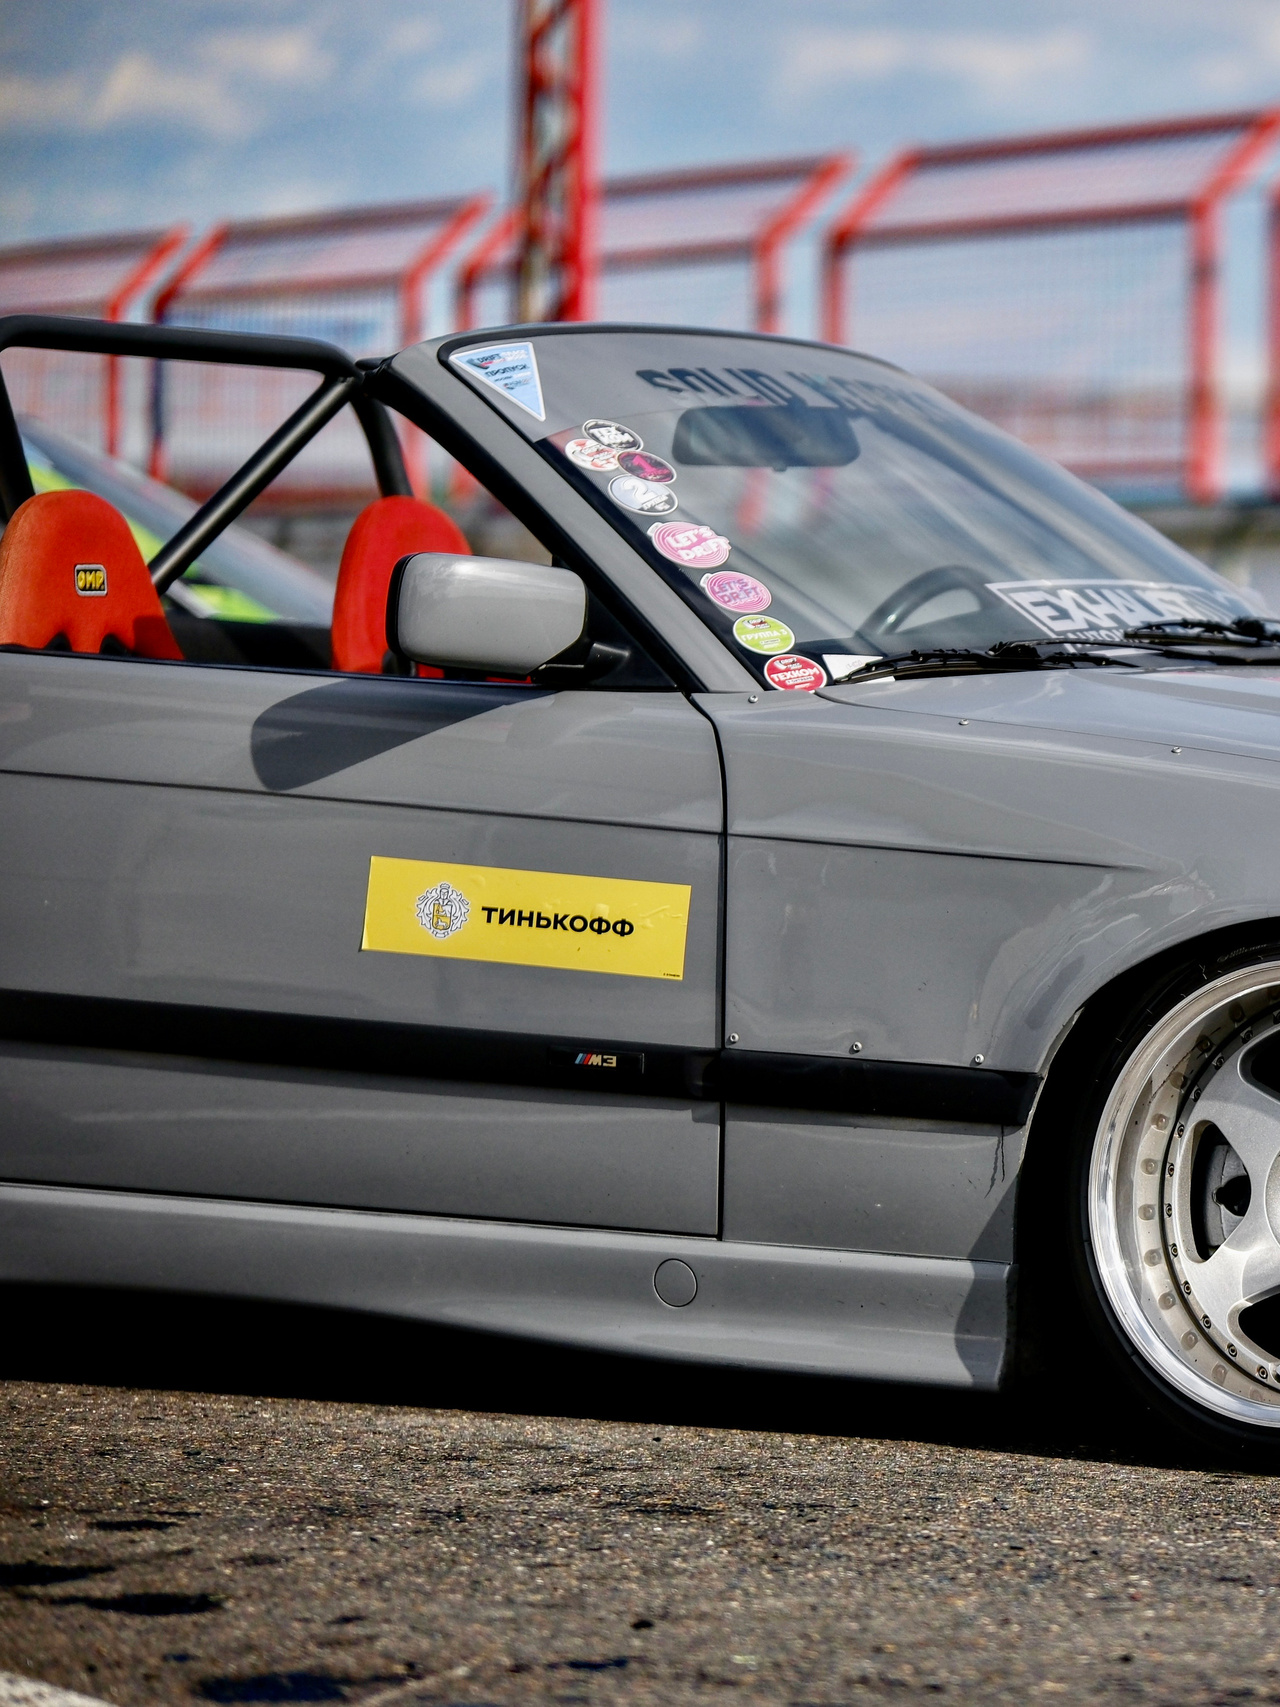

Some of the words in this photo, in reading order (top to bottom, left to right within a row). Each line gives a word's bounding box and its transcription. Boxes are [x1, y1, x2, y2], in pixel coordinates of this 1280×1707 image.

[665, 528, 713, 548] LET'S
[677, 537, 731, 560] DRIFT
[481, 906, 635, 937] ТИНЬКОФФ
